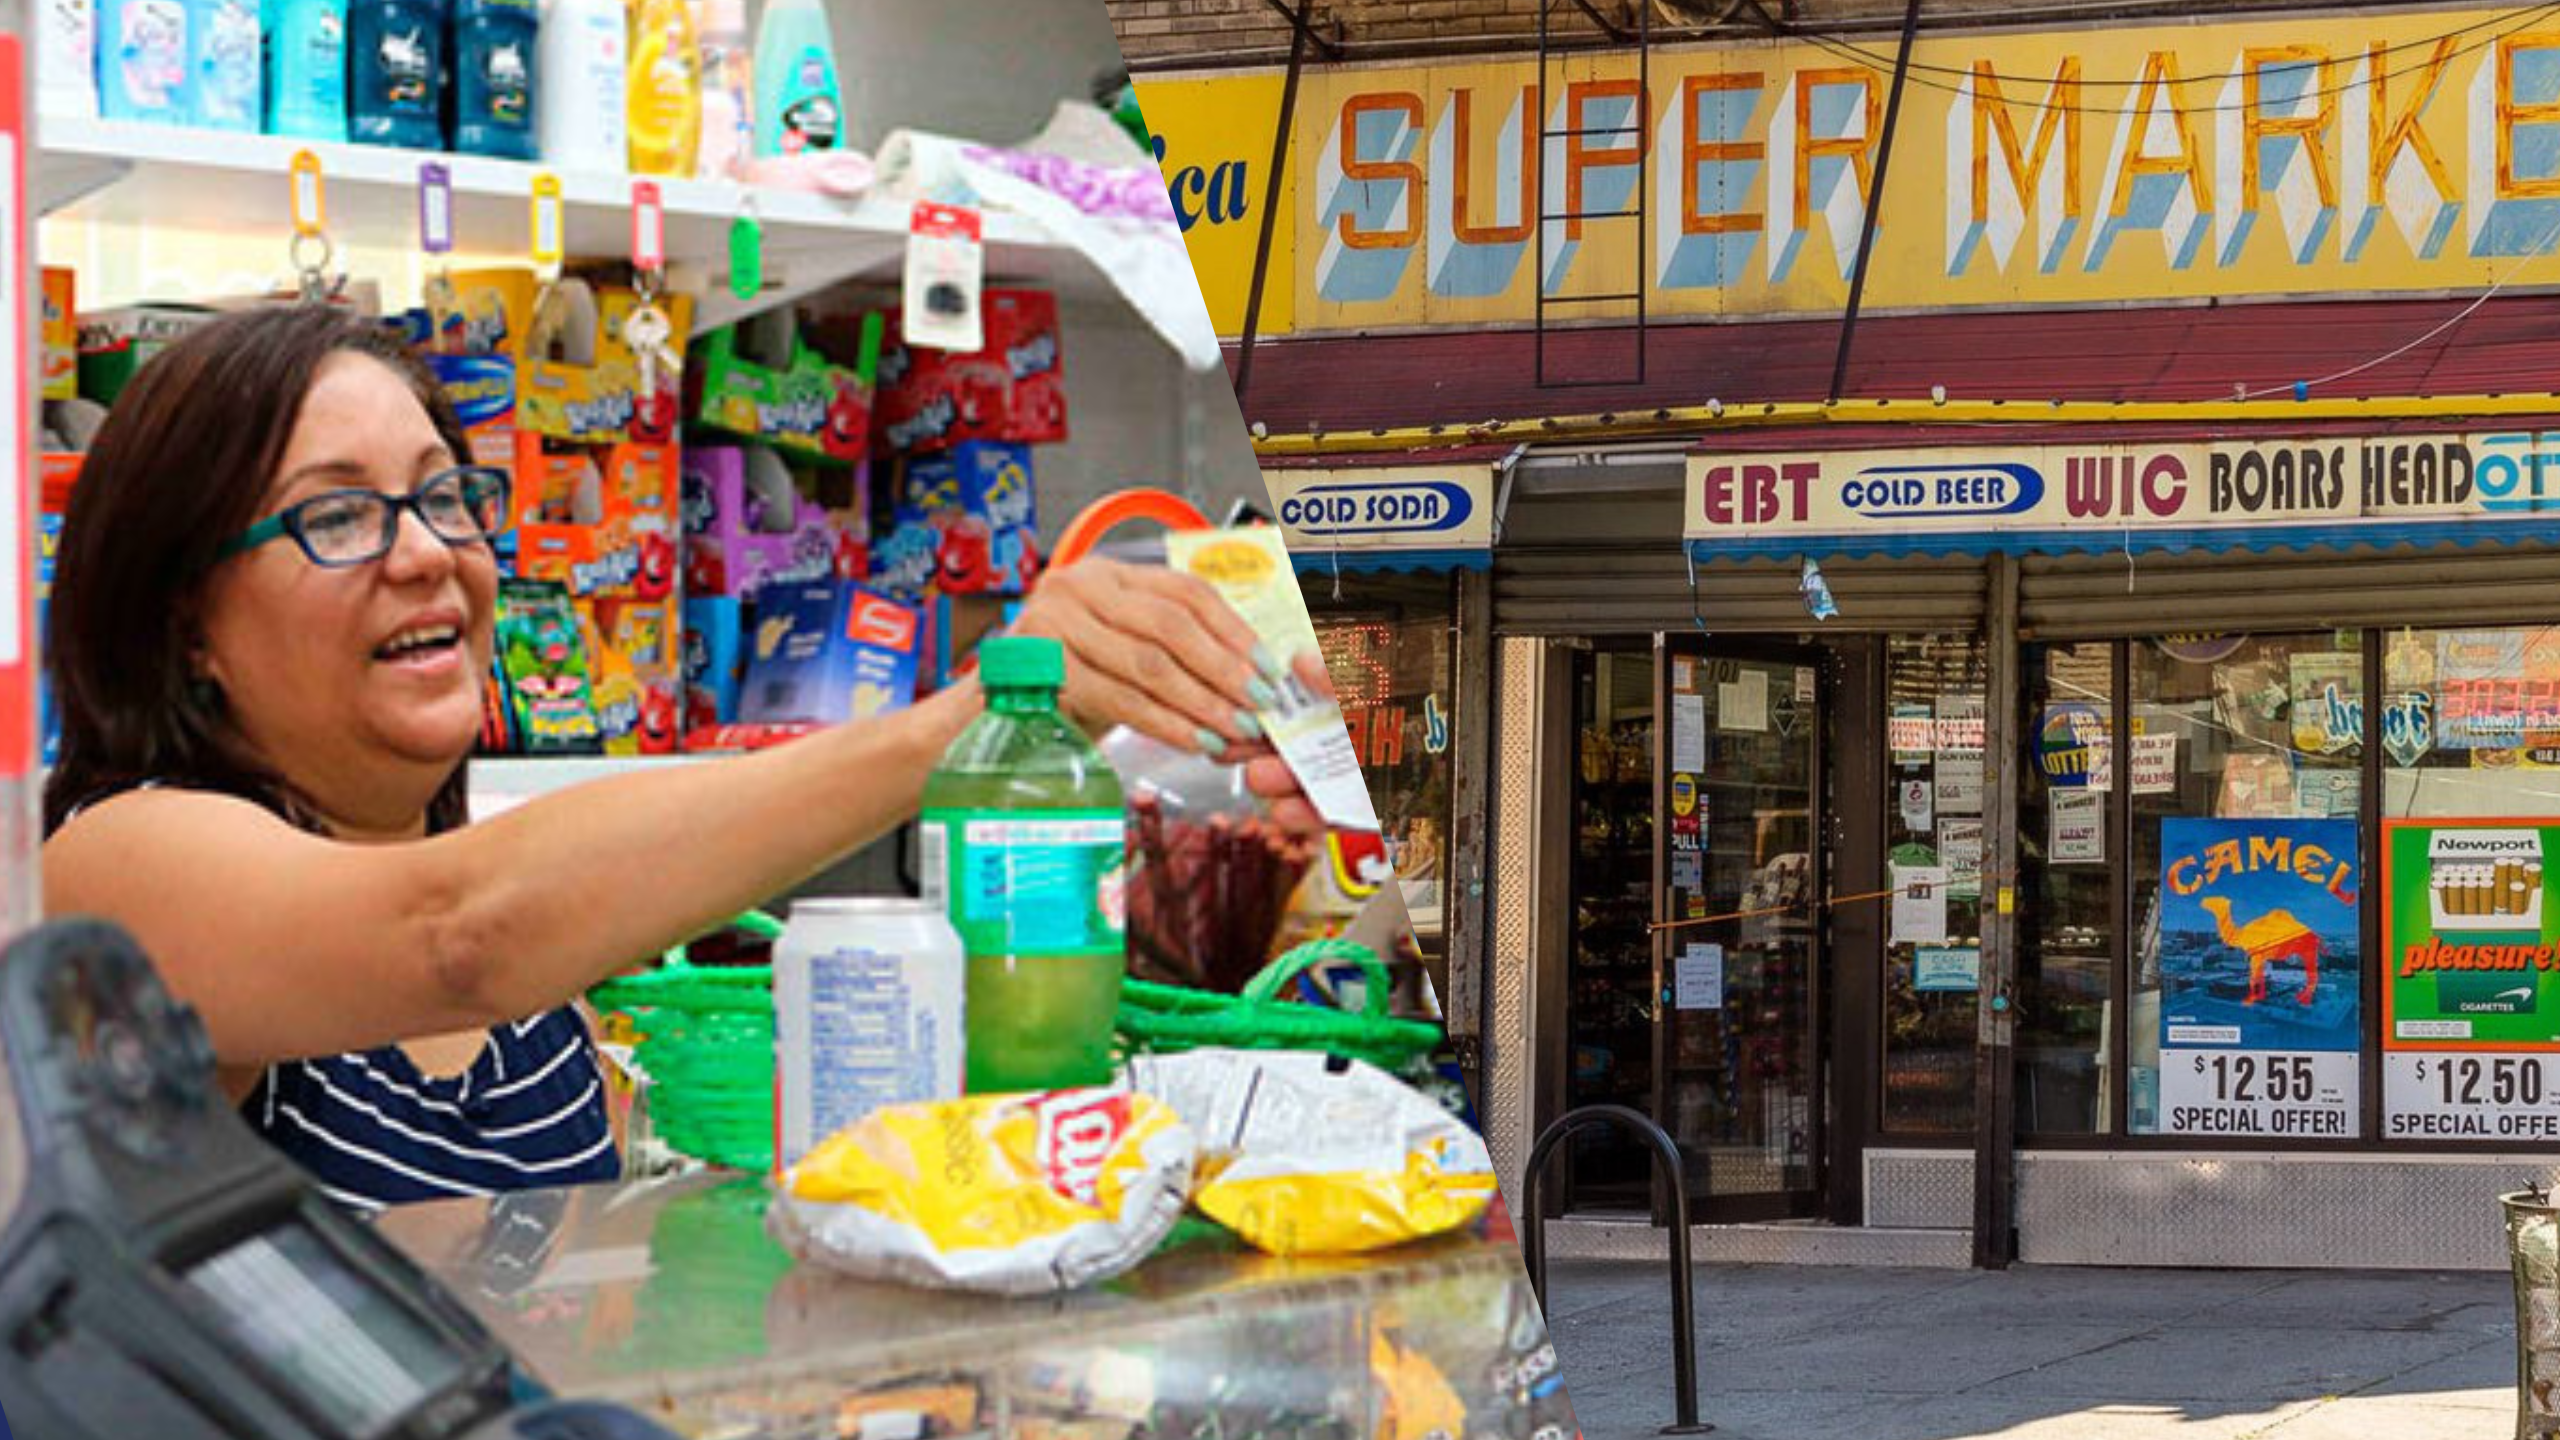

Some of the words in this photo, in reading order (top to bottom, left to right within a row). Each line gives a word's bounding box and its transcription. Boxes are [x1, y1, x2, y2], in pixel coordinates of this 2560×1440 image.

[1322, 68, 1884, 290] SUPER
[1952, 32, 2560, 268] MARKE
[1703, 460, 1820, 525] EBT
[1840, 478, 1926, 509] COLD
[1935, 476, 2006, 506] BEER
[2065, 453, 2189, 519] WIC
[2209, 444, 2344, 514] BOARS
[2361, 442, 2474, 508] HEAD
[2475, 450, 2560, 499] OT
[1281, 495, 1356, 526] COLD
[1365, 492, 1440, 523] SODA
[2437, 838, 2536, 852] Newport
[2166, 836, 2356, 906] CAMEL
[2459, 1002, 2516, 1012] CIGARETTES
[2194, 1055, 2206, 1074] $
[2211, 1055, 2314, 1102] 12.55
[2415, 1059, 2426, 1082] $
[2437, 1058, 2542, 1105] 12.50
[2172, 1106, 2264, 1132] SPECIAL
[2271, 1108, 2346, 1134] OFFER!
[2391, 1113, 2492, 1135] SPECIAL
[2498, 1114, 2559, 1136] OFFE
